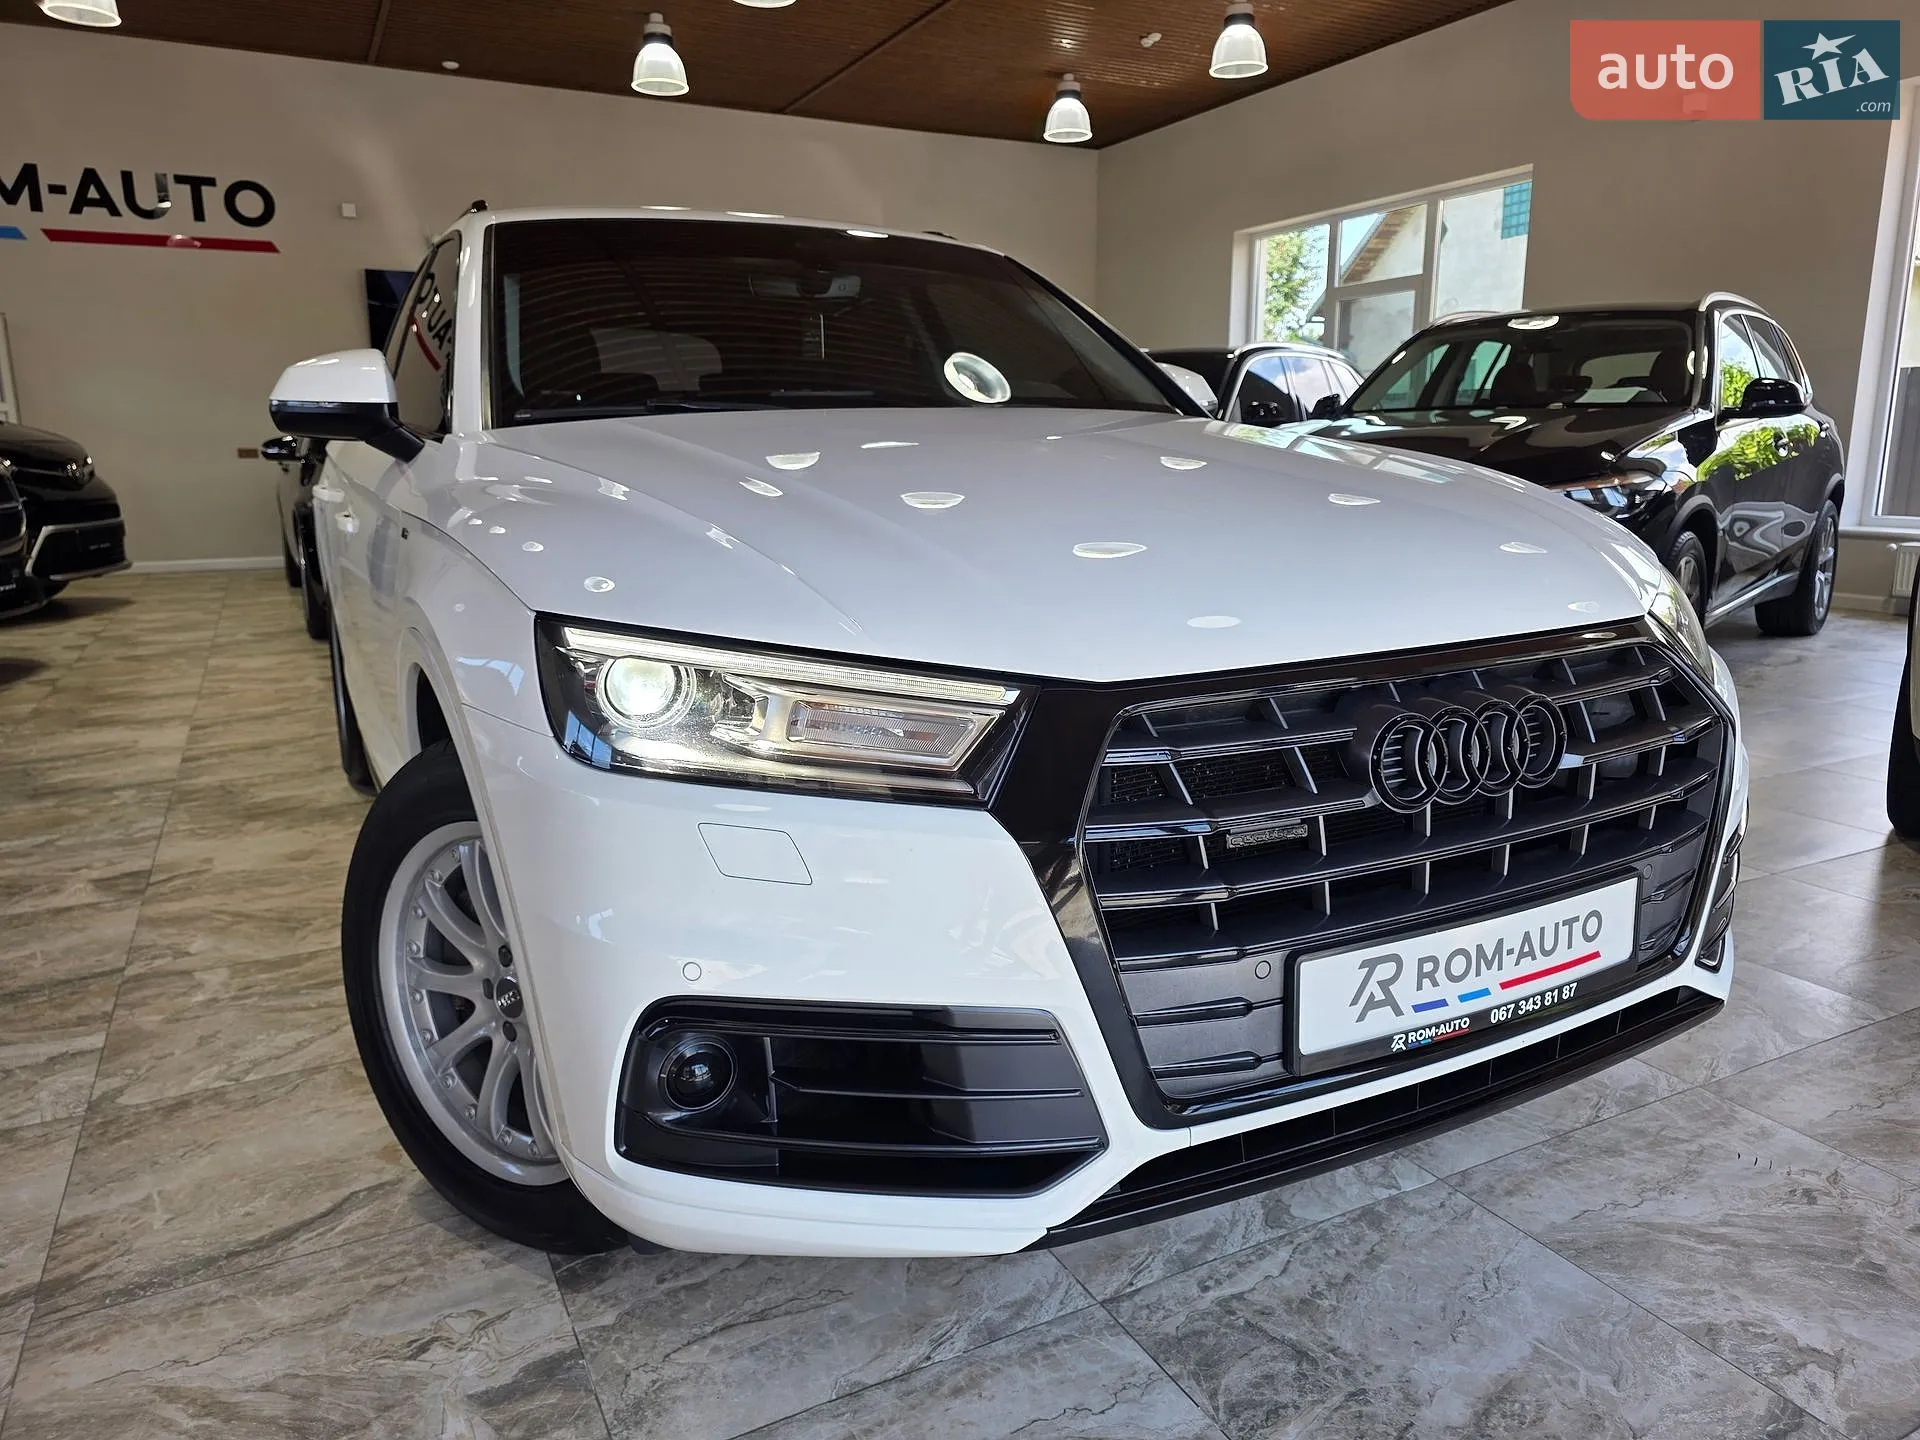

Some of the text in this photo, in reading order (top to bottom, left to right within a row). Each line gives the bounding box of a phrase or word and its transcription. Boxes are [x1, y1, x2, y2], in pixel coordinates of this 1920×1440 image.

[1416, 909, 1603, 992] ROM-AUTO
[1490, 982, 1578, 1024] 067 343 81 87
[1408, 1017, 1470, 1043] ROM-AUTO
